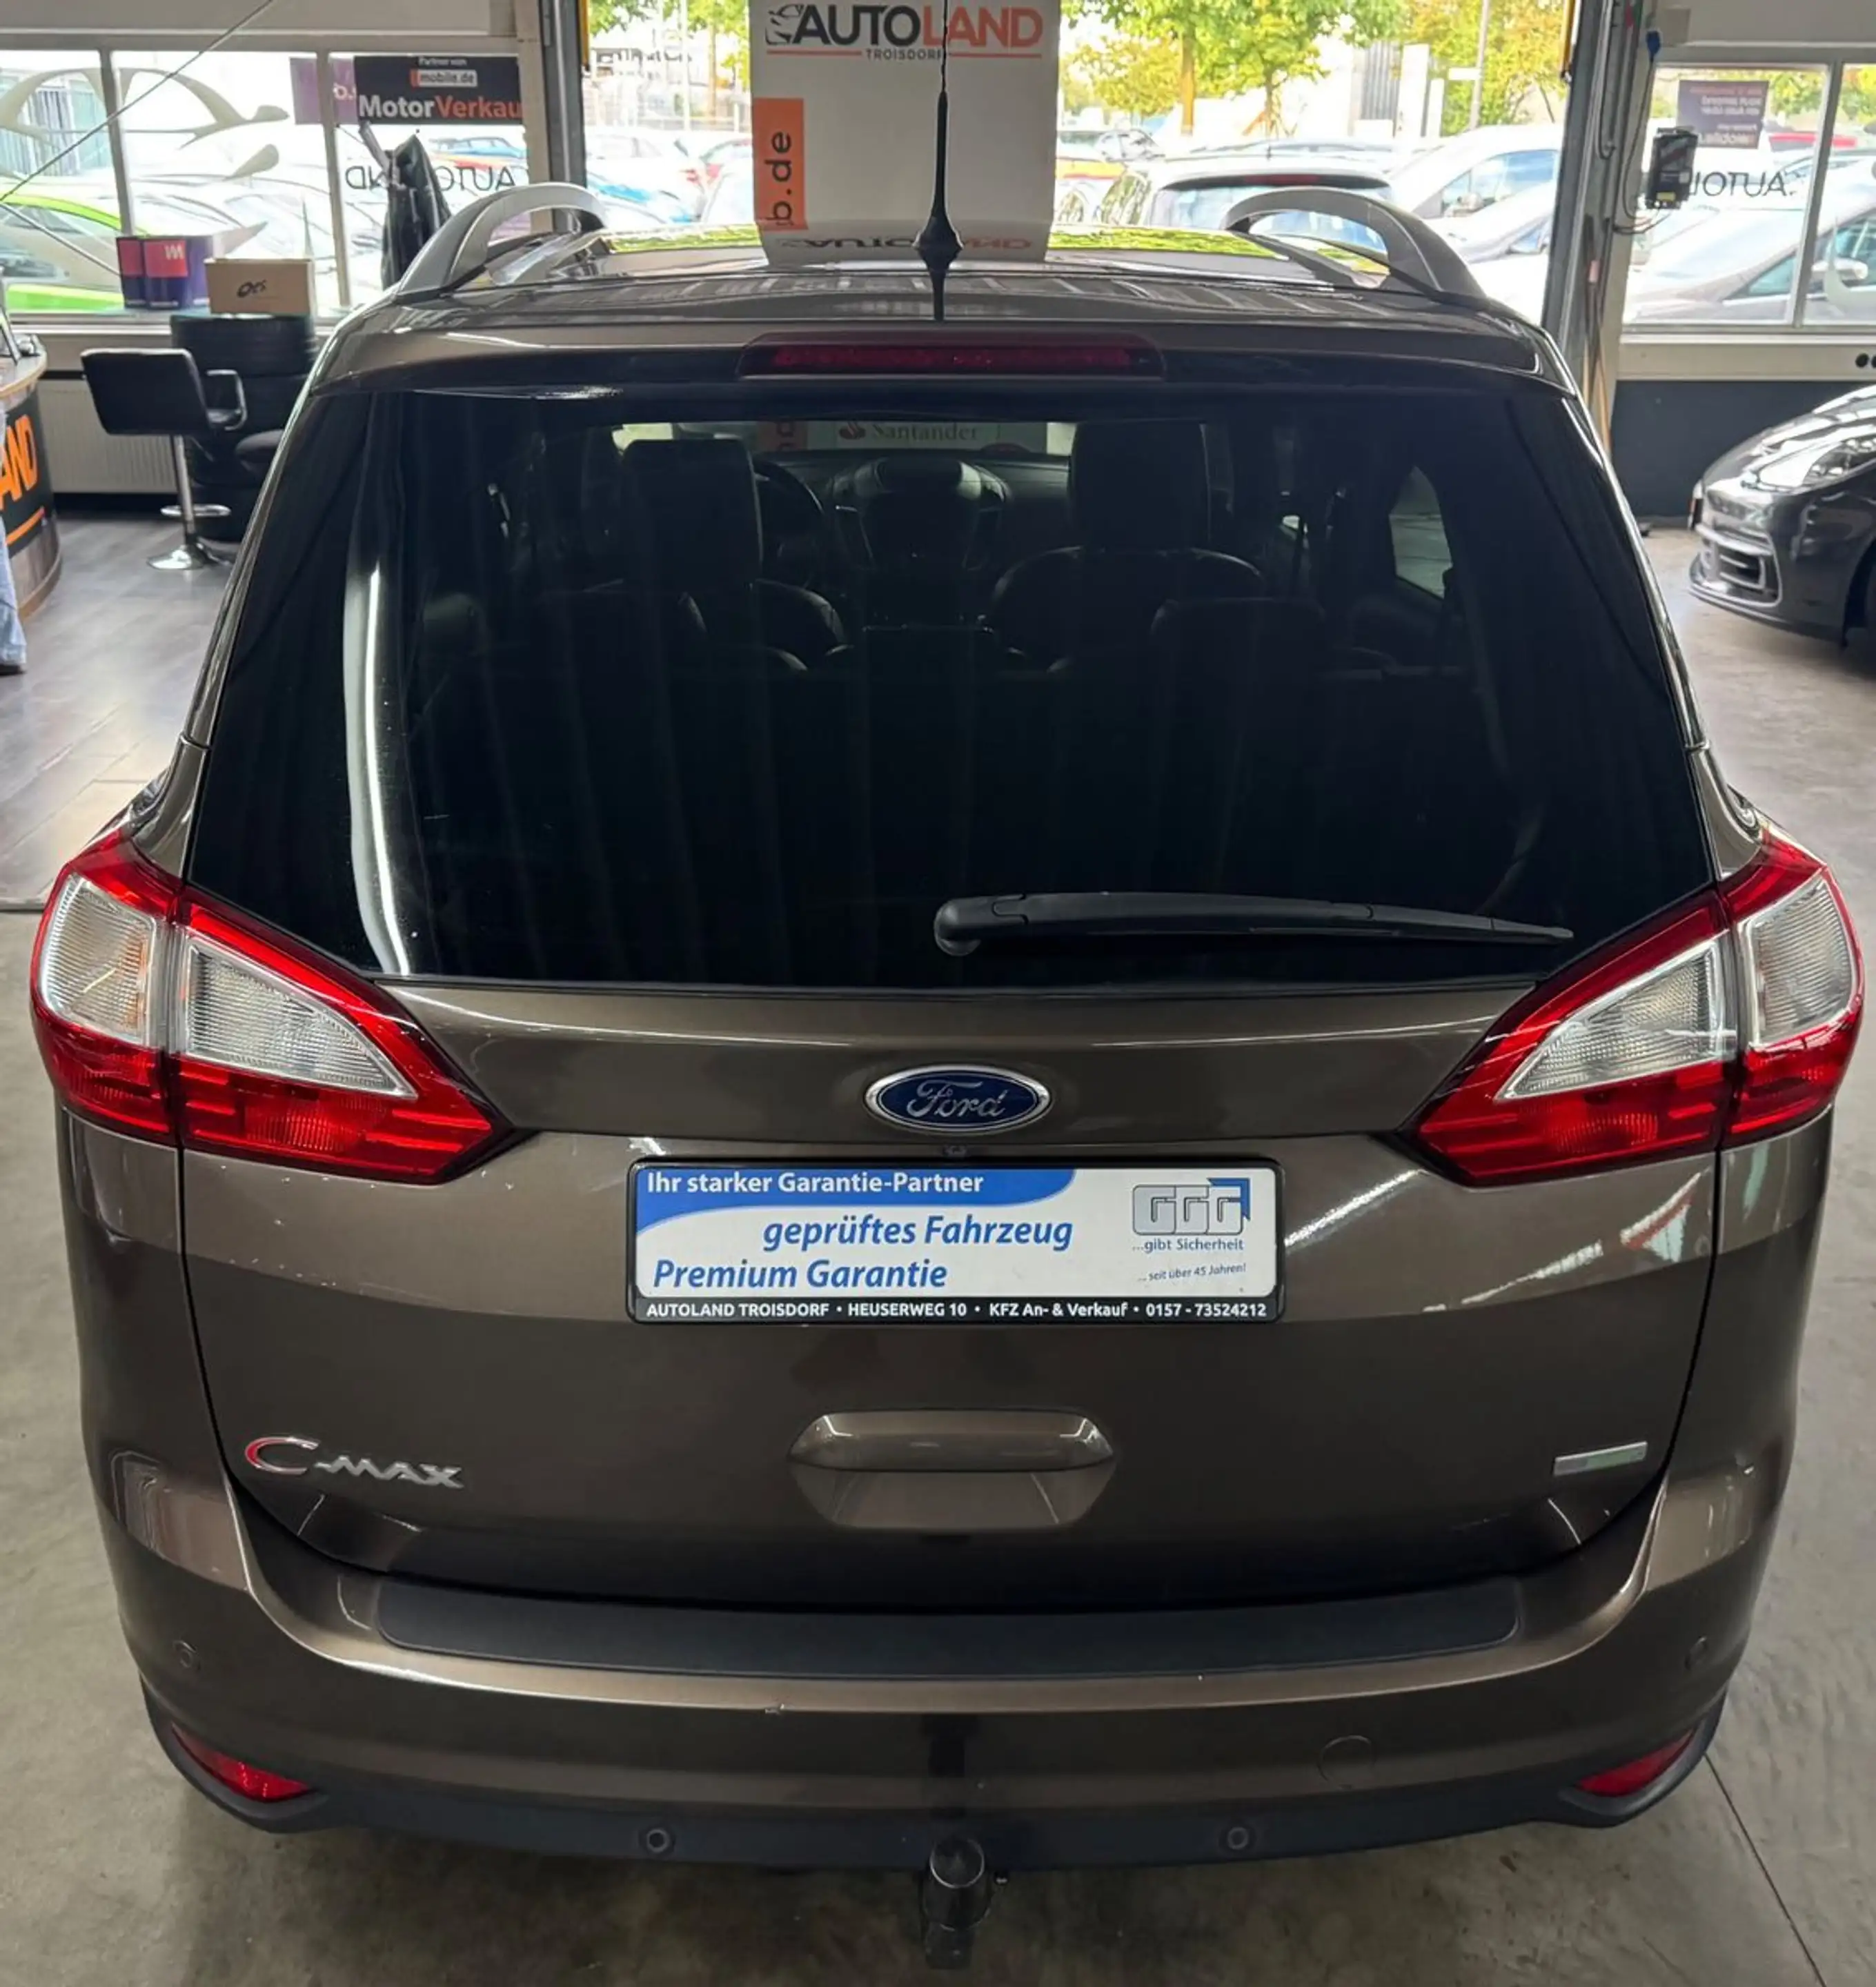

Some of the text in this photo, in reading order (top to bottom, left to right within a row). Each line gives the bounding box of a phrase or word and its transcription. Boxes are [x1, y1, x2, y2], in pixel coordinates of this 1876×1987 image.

[793, 4, 1044, 48] AUTOLAND
[907, 1079, 1008, 1118] Ford
[648, 1172, 984, 1192] Ihr starker Garantie-Partner
[763, 1214, 1073, 1252] geprüftes Fahrzeug
[1177, 1238, 1244, 1251] Sicherheit
[654, 1259, 947, 1288] Premium Garantie
[1169, 1267, 1192, 1279] über
[1194, 1265, 1206, 1276] 45
[646, 1303, 735, 1316] AUTOLAND
[739, 1303, 829, 1316] TROISDORF
[848, 1303, 945, 1316] HEUSERWEG
[949, 1303, 967, 1316] 10
[989, 1303, 1018, 1316] KFZ
[1023, 1303, 1049, 1316] An-
[1052, 1303, 1063, 1316] &
[1067, 1303, 1128, 1316] Verkauf
[1145, 1303, 1181, 1317] 0157
[1195, 1303, 1267, 1317] 73524212
